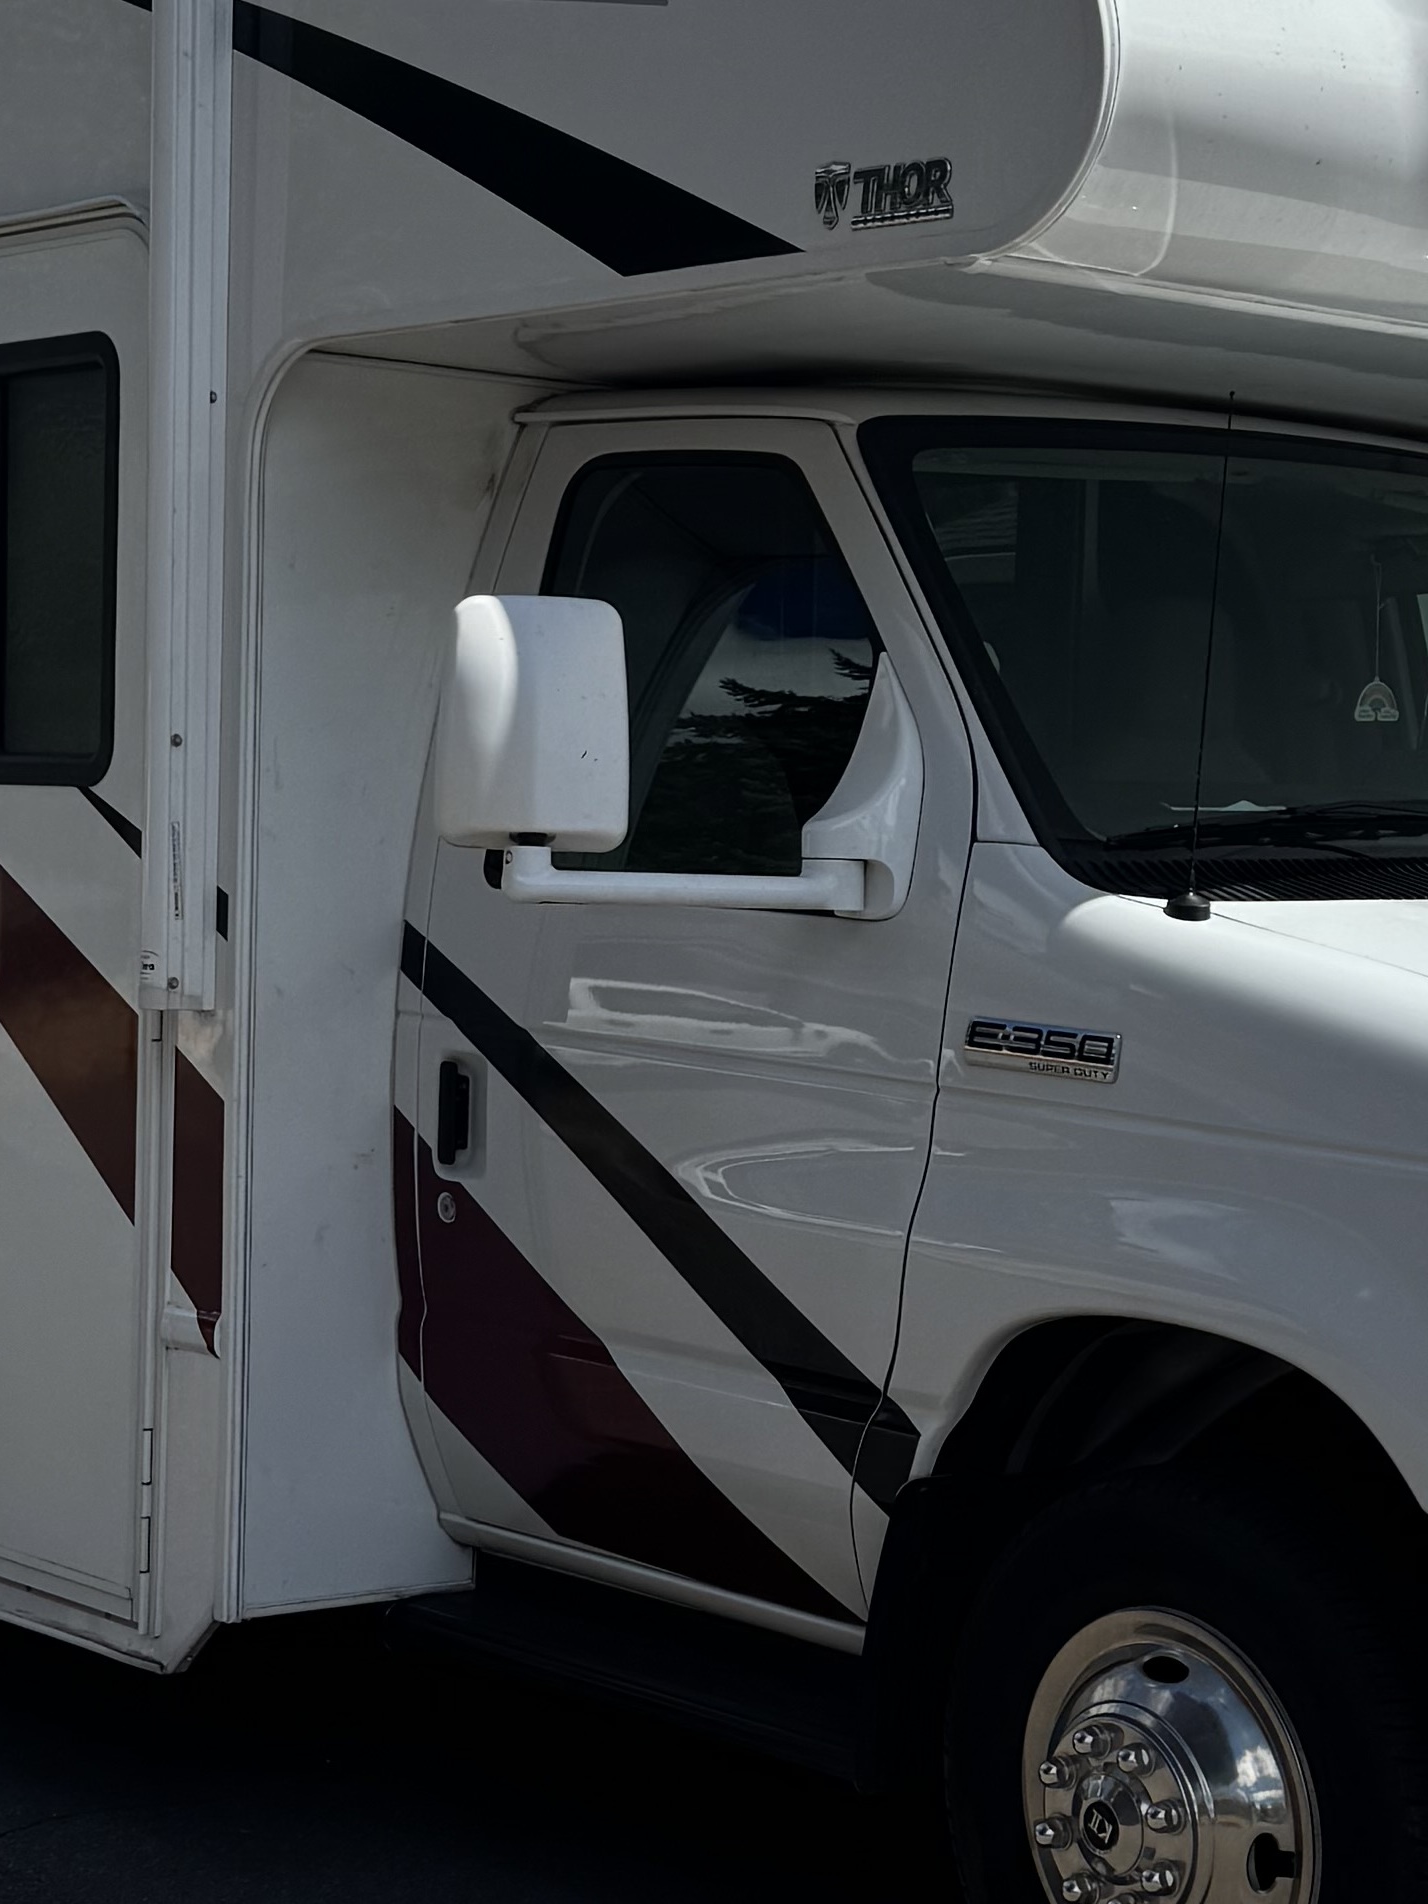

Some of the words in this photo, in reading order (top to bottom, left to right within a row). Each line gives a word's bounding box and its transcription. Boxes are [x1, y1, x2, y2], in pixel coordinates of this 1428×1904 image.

[853, 156, 953, 215] THOR
[1028, 1061, 1071, 1076] SUPER
[1073, 1067, 1111, 1081] DUTY
